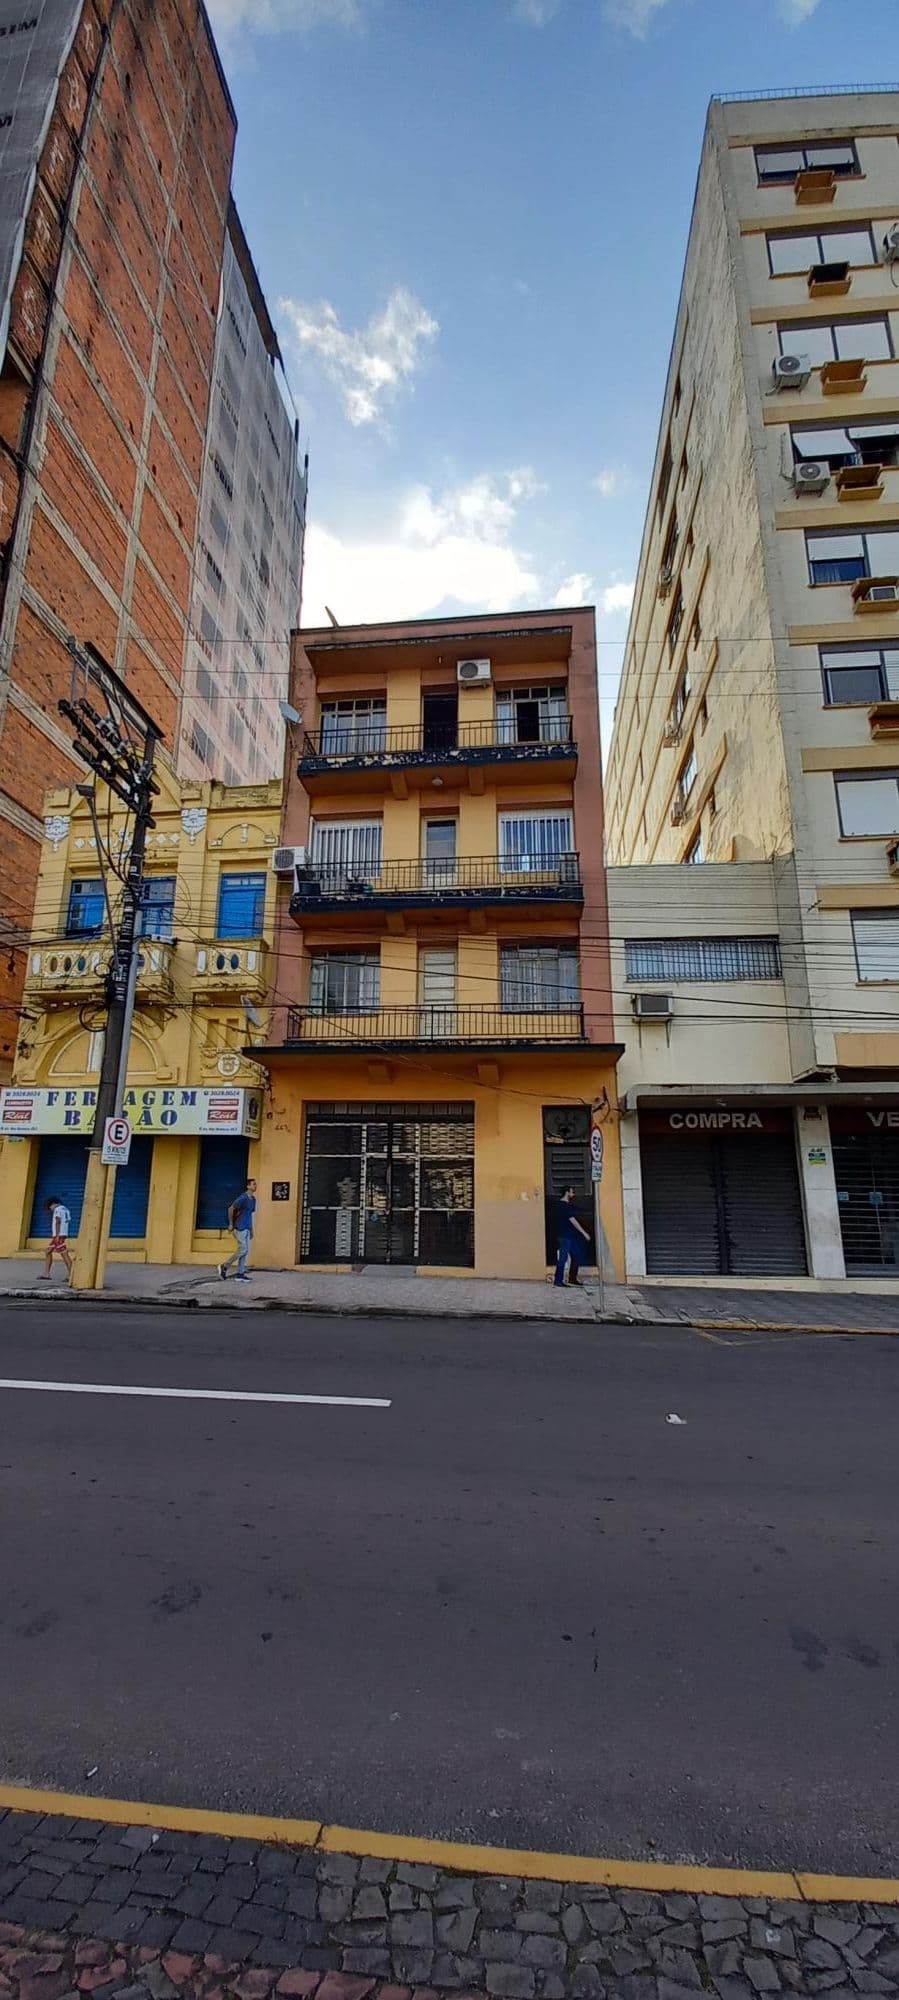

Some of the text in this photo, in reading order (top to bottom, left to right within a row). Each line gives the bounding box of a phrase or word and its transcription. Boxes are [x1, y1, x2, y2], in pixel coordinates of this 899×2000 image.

[46, 1090, 198, 1106] FERAGEM
[63, 1106, 178, 1126] BÃO
[669, 1112, 764, 1129] COMPRA
[114, 1124, 124, 1140] E
